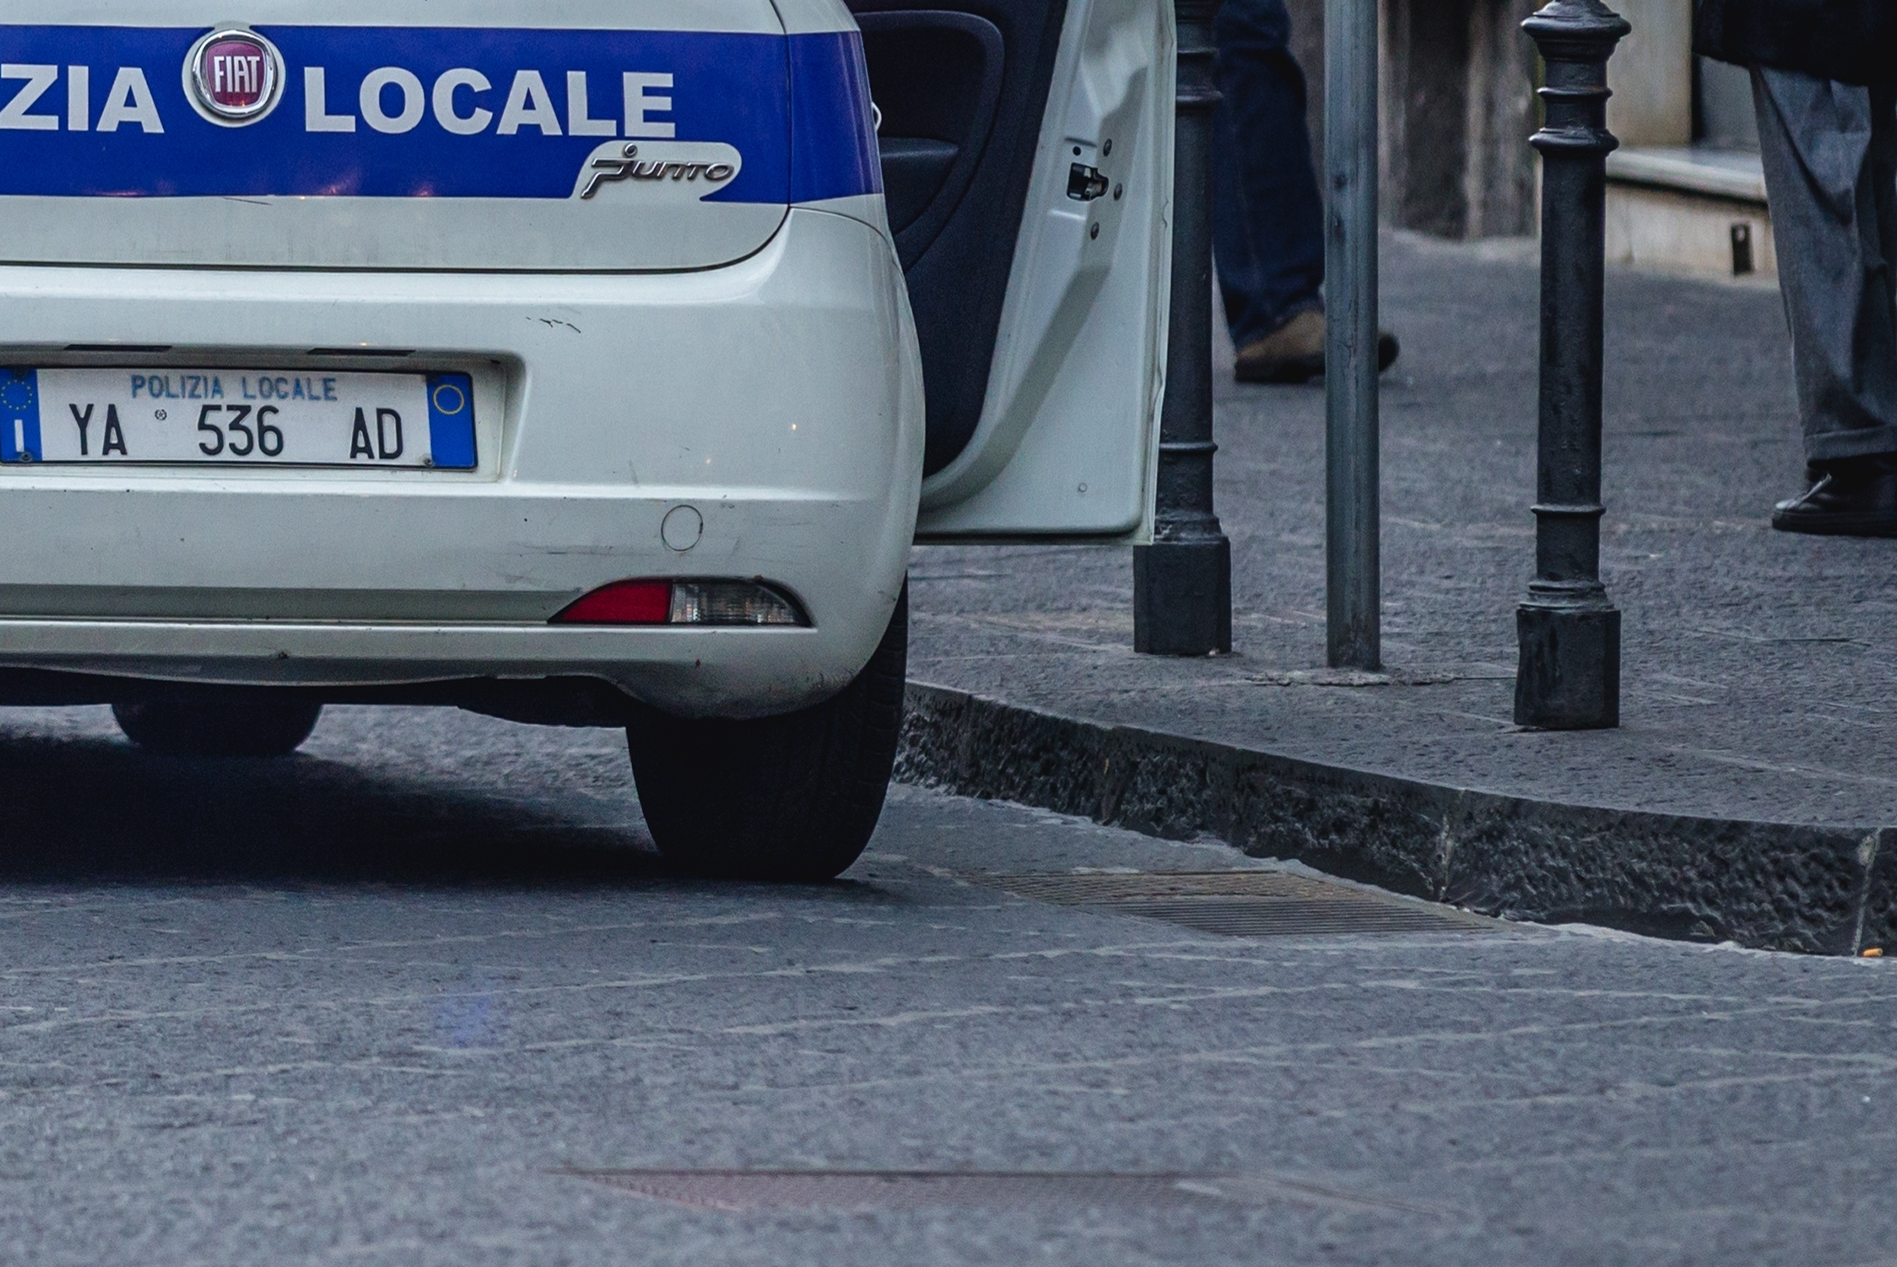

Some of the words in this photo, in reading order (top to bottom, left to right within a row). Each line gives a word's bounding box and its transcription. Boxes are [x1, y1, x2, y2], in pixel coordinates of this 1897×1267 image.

[213, 55, 261, 93] FIAT
[304, 66, 676, 138] LOCALE
[130, 373, 225, 400] POLIZIA
[241, 375, 338, 402] LOCALE
[68, 403, 128, 456] YA
[197, 404, 284, 457] 536
[349, 406, 404, 460] AD
